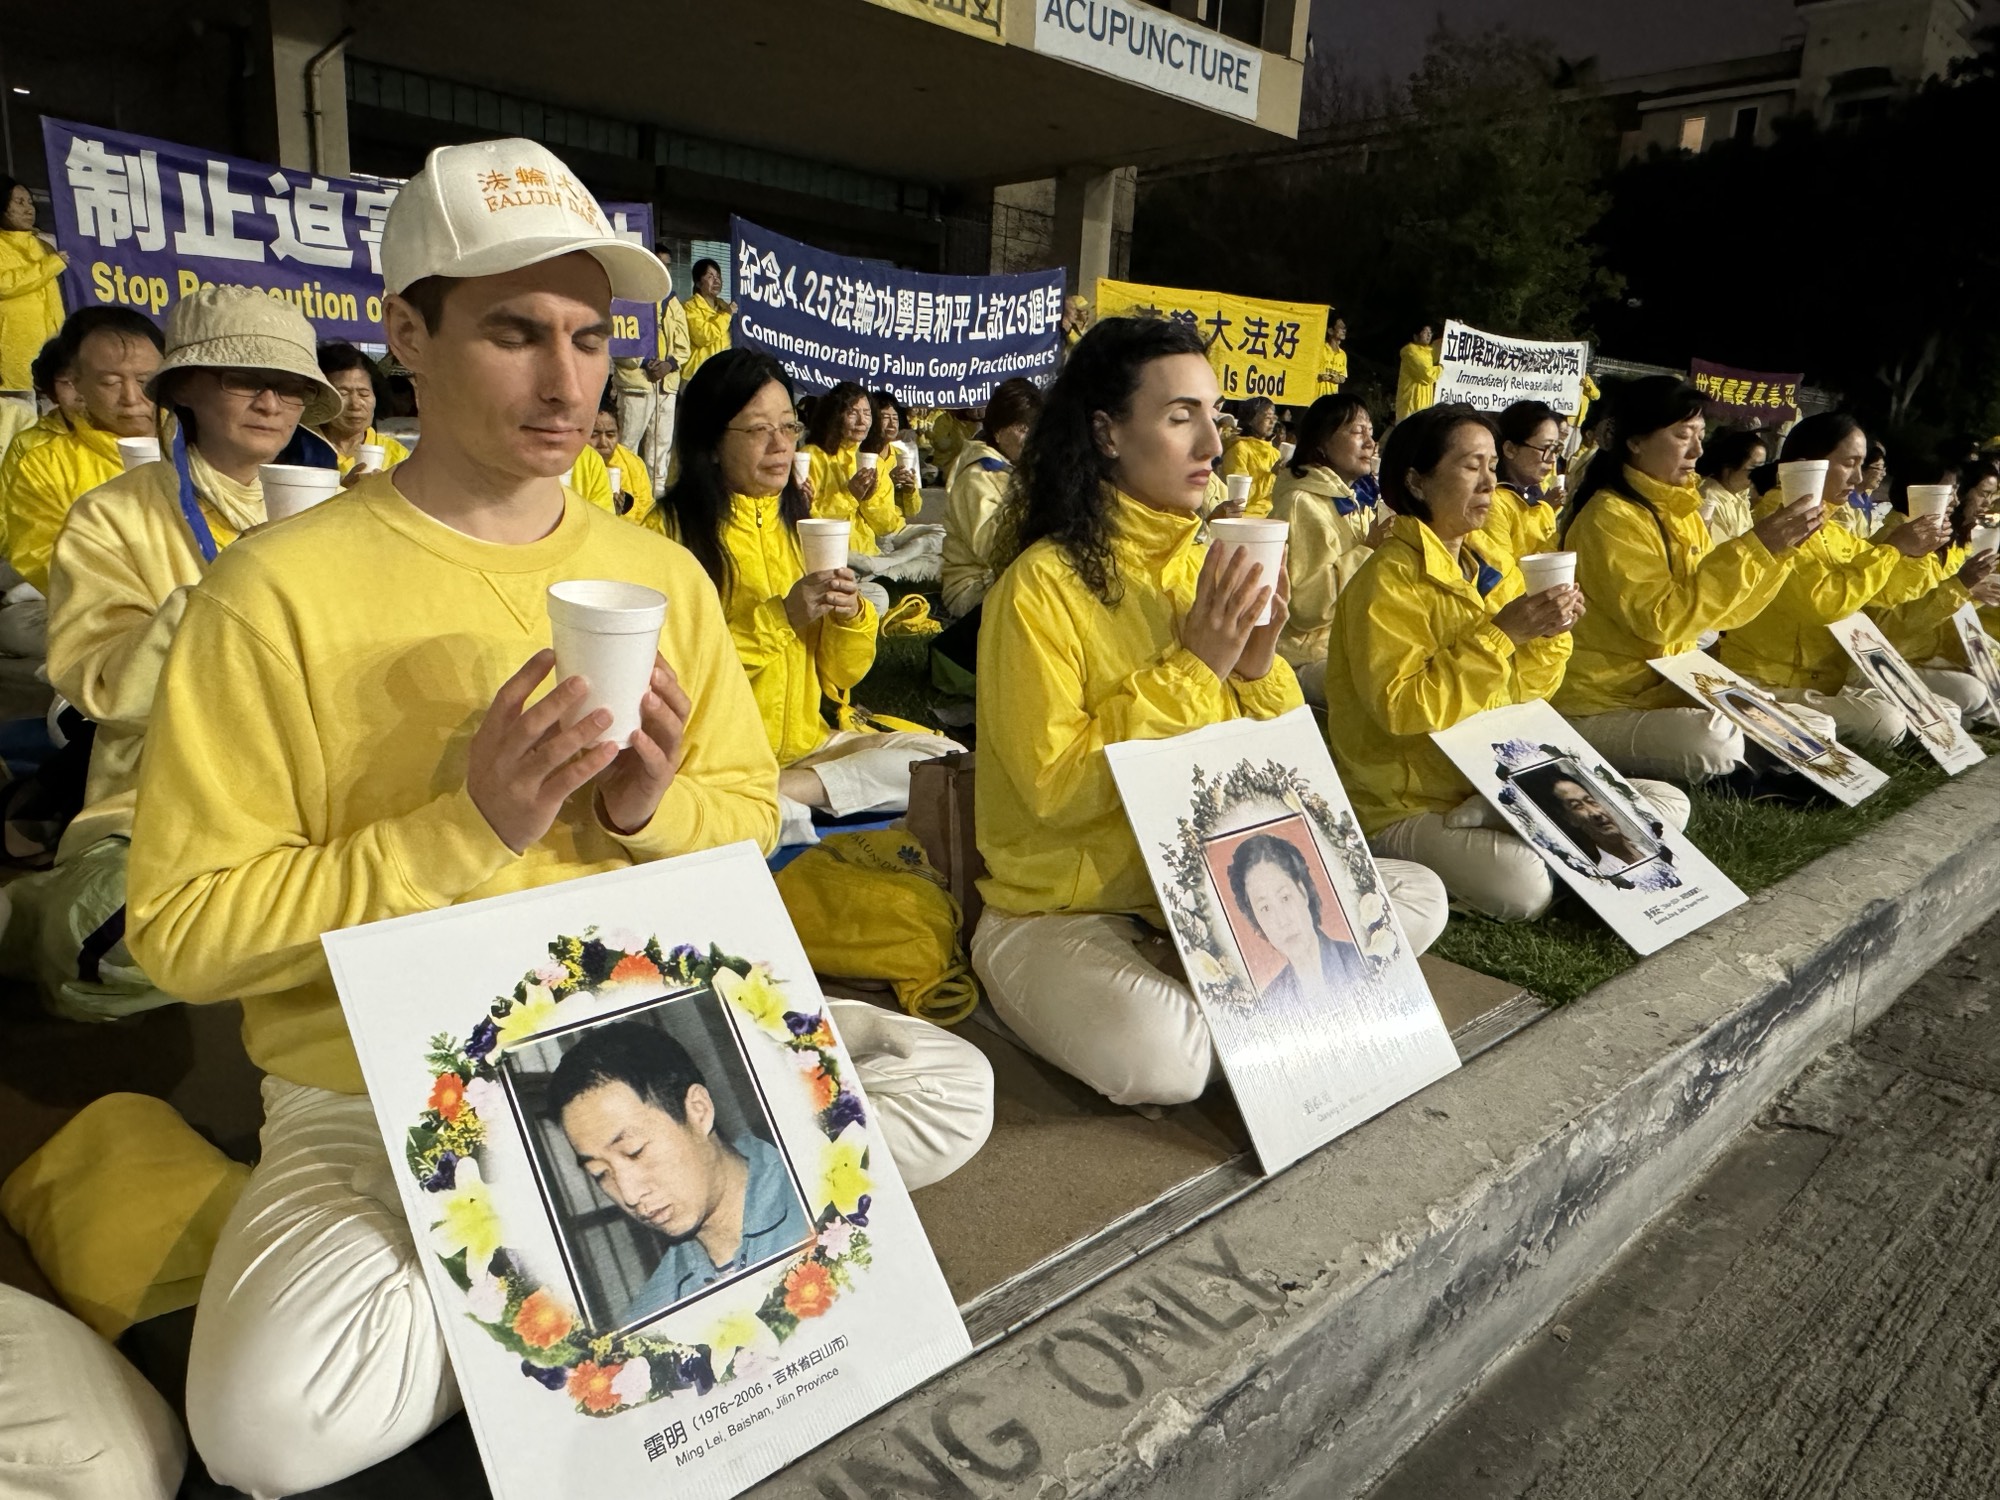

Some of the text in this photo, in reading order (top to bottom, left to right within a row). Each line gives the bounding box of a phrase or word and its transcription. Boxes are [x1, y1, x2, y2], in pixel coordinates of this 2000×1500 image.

[1043, 0, 1251, 93] ACUPUNCTURE
[484, 190, 561, 212] FALUN
[92, 262, 169, 315] Stop
[741, 315, 1058, 381] Commemorating Falun Gong Practitioners'
[885, 383, 934, 408] Beijing
[938, 389, 955, 404] on
[959, 382, 990, 406] April
[1223, 364, 1286, 397] Is Good
[1440, 388, 1463, 403] Falun
[1465, 391, 1489, 409] Gong
[1552, 398, 1574, 411] China
[1456, 370, 1508, 392] Immediately
[1038, 1234, 1289, 1408] ONLY
[676, 1445, 705, 1466] Ming
[705, 1431, 727, 1450] Lei,
[728, 1405, 774, 1437] Baishan,
[796, 1367, 840, 1397] Province
[643, 1420, 688, 1462] 雷明
